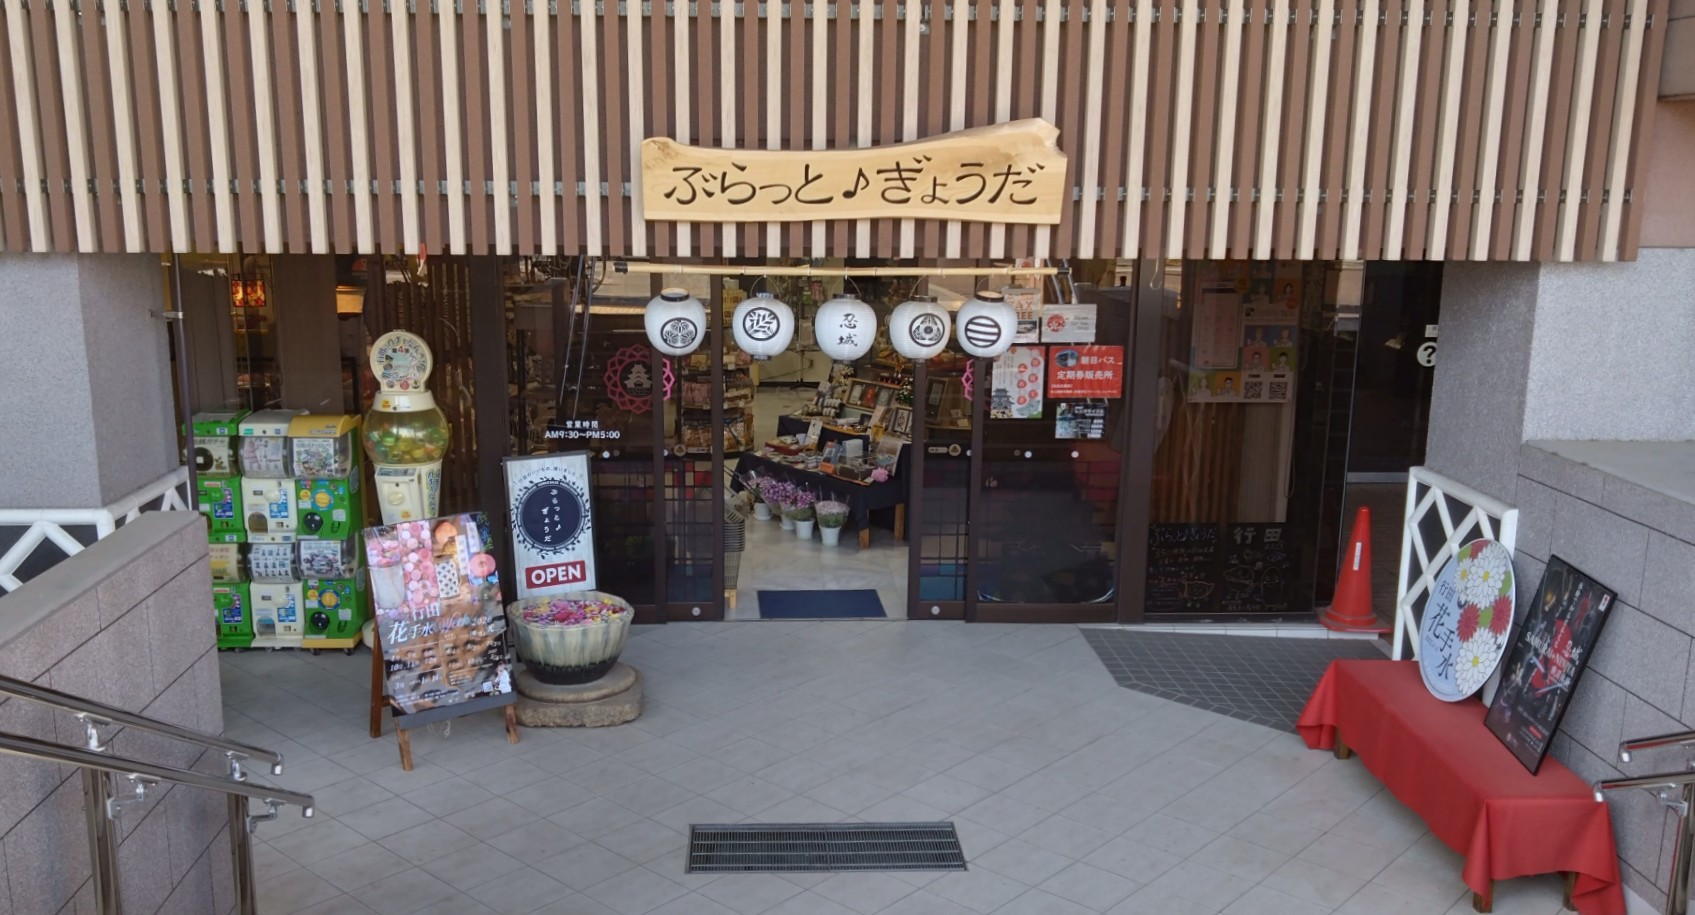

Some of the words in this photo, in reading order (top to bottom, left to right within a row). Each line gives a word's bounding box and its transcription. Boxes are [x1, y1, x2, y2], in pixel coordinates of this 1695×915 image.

[837, 313, 858, 347] 忍城
[1081, 356, 1115, 365] 朝日バス
[1056, 370, 1114, 380] 定期券販売所
[566, 420, 599, 429] 営業時間
[1233, 527, 1282, 544] 行田
[531, 564, 582, 585] OPEN
[1438, 579, 1457, 603] 行田
[412, 603, 441, 621] 行田
[1428, 602, 1456, 681] 花手水
